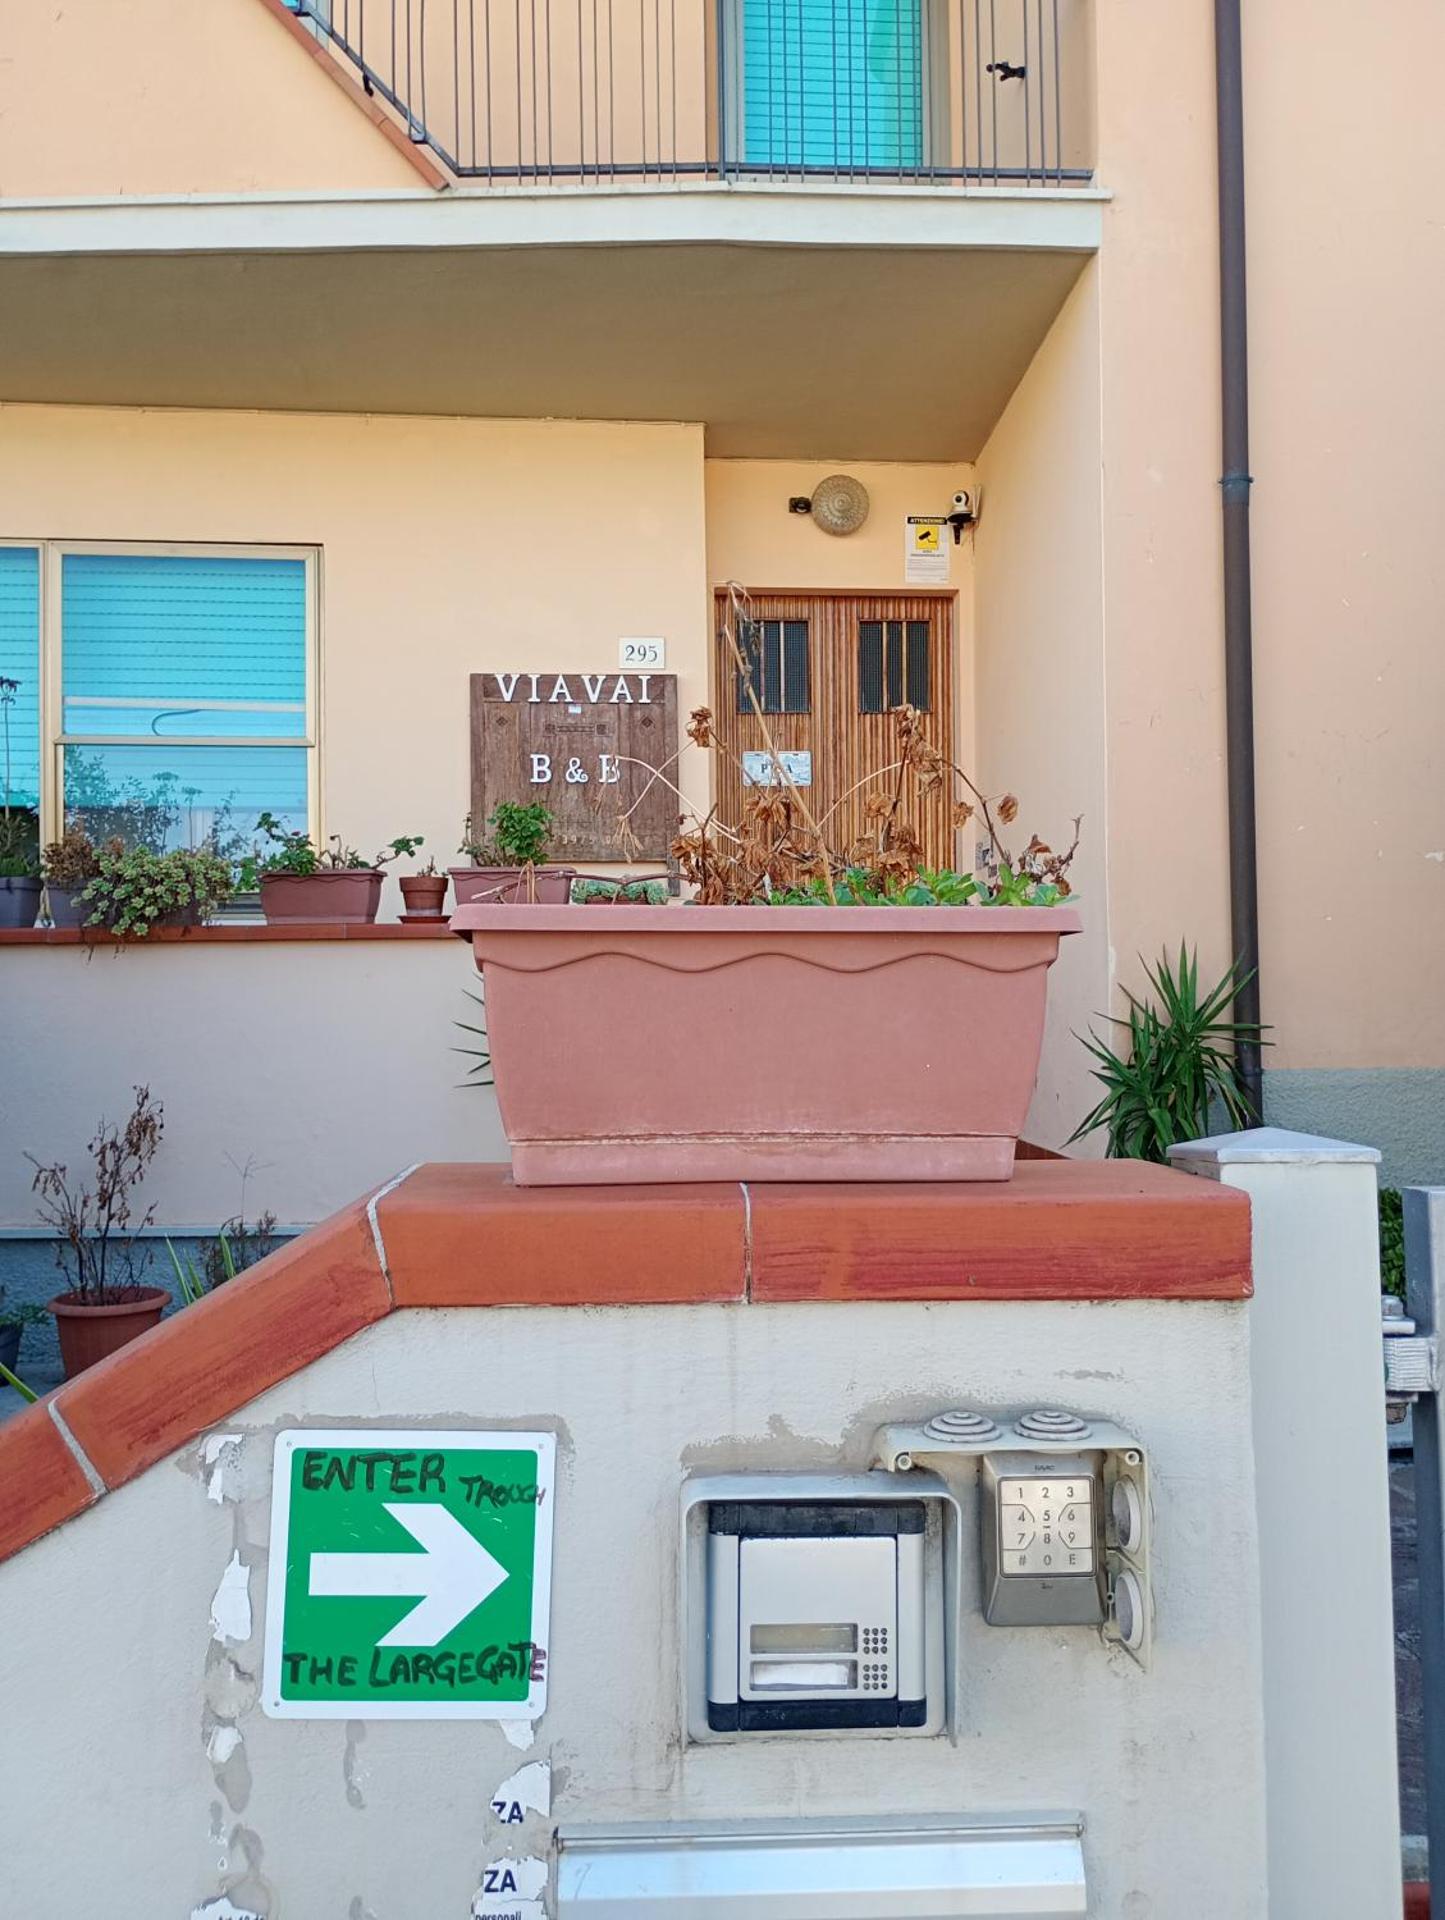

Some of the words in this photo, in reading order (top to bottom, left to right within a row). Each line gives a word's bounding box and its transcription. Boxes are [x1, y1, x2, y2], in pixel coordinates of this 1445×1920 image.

[625, 644, 658, 662] 295
[495, 674, 651, 704] VIAVAI
[530, 753, 552, 783] B
[565, 757, 589, 783] &
[598, 753, 620, 783] B
[302, 1451, 446, 1494] ENTER
[1018, 1486, 1024, 1499] 1
[1042, 1486, 1050, 1499] 2
[1066, 1486, 1074, 1498] 3
[1017, 1510, 1026, 1523] 4
[1043, 1509, 1051, 1522] 5
[1067, 1509, 1076, 1521] 6
[1017, 1532, 1026, 1545] 7
[1043, 1532, 1052, 1544] 8
[1068, 1531, 1076, 1544] 9
[1017, 1553, 1027, 1567] #
[1069, 1553, 1077, 1565] E
[283, 1652, 359, 1687] THE
